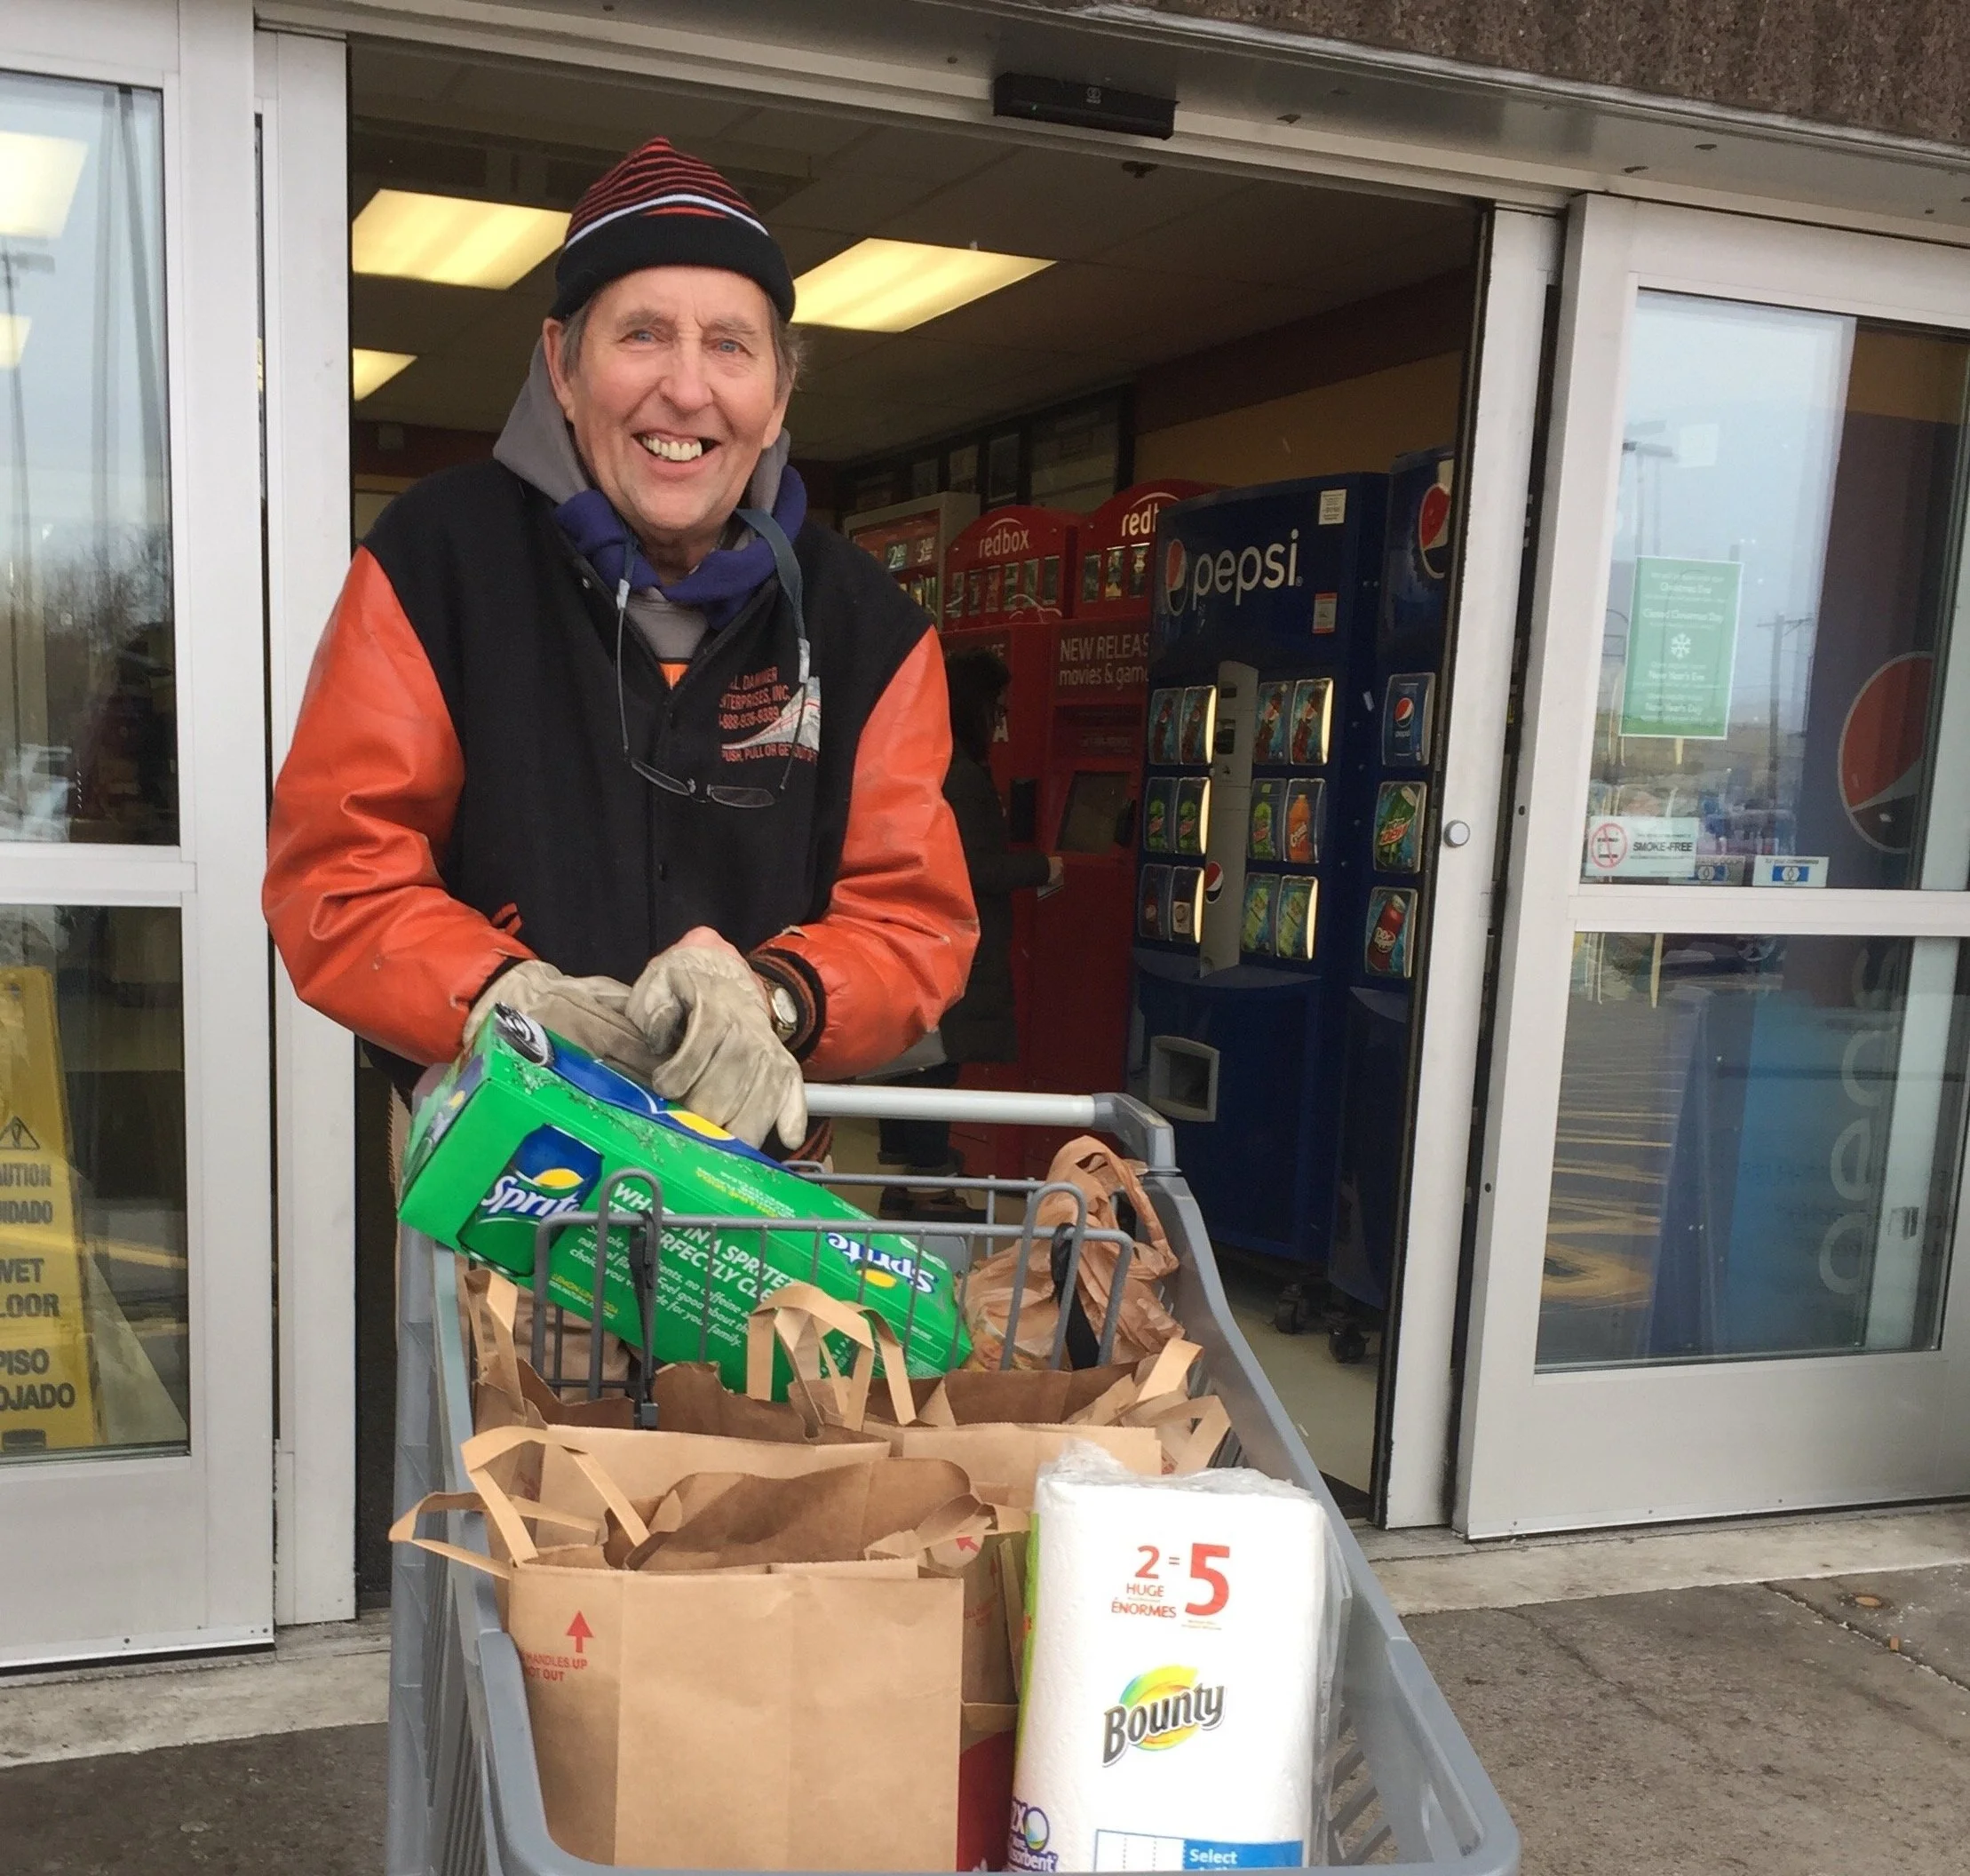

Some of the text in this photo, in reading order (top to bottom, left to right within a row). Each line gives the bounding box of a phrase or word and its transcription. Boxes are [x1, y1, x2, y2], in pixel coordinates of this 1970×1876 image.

[979, 528, 1030, 559] redbox
[1192, 529, 1299, 611] pepsi
[1060, 636, 1094, 662] NEW
[1059, 667, 1102, 686] movies
[1105, 663, 1115, 683] &
[1632, 841, 1694, 852] SMOKE-FREE
[0, 1163, 52, 1187] UTION
[721, 1245, 796, 1288] SPRTE
[700, 1288, 742, 1313] cffeine
[737, 1277, 774, 1303] CLE
[683, 1312, 703, 1327] you
[1126, 1582, 1164, 1598] HUGE
[1135, 1546, 1160, 1579] 2
[1185, 1542, 1230, 1617] 5
[543, 1669, 565, 1681] OUT
[572, 1658, 588, 1670] UP
[1102, 1681, 1225, 1766] Bounty
[1189, 1848, 1238, 1865] Select
